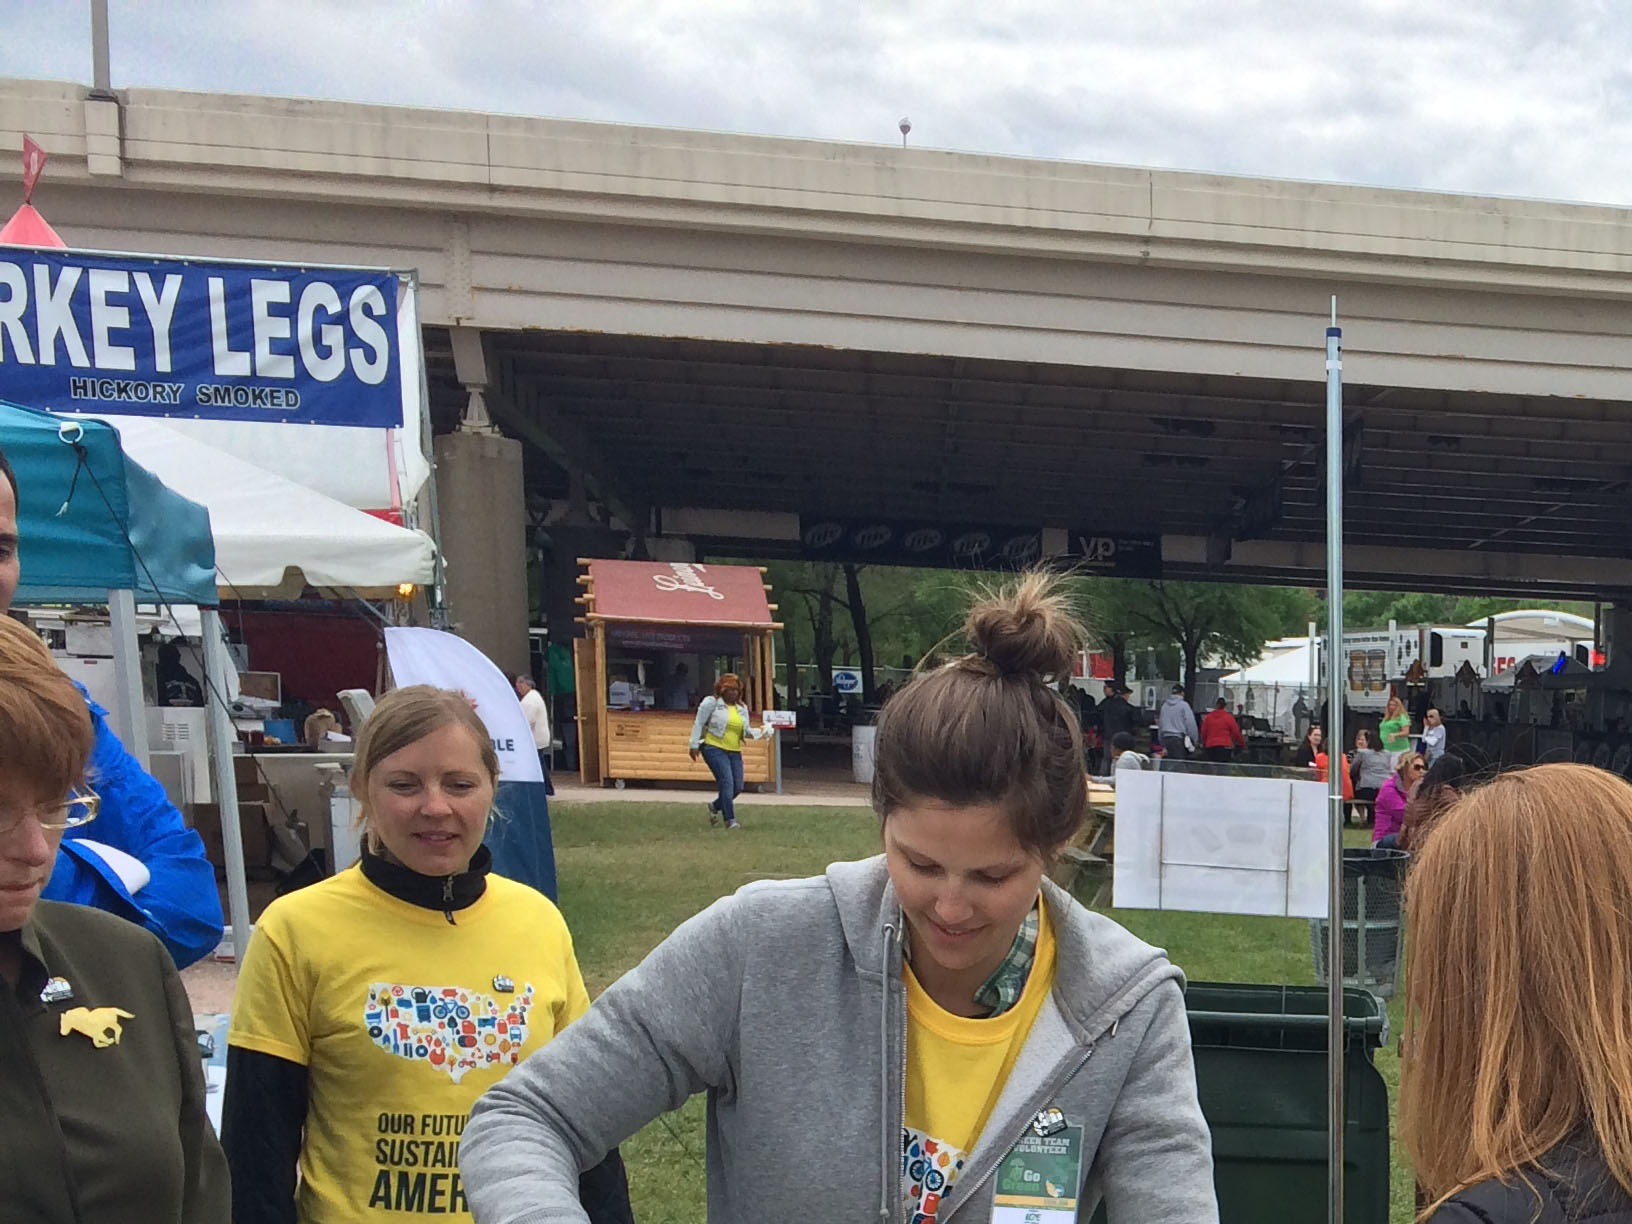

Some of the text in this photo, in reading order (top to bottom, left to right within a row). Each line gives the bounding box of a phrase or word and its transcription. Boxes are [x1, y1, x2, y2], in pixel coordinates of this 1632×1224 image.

[0, 261, 390, 385] RKEY LEGS
[70, 377, 301, 409] HICKORY SMOKED
[378, 1112, 470, 1136] OUR FUTU
[1021, 1136, 1070, 1147] EEN TEAM
[1023, 1169, 1041, 1182] Go
